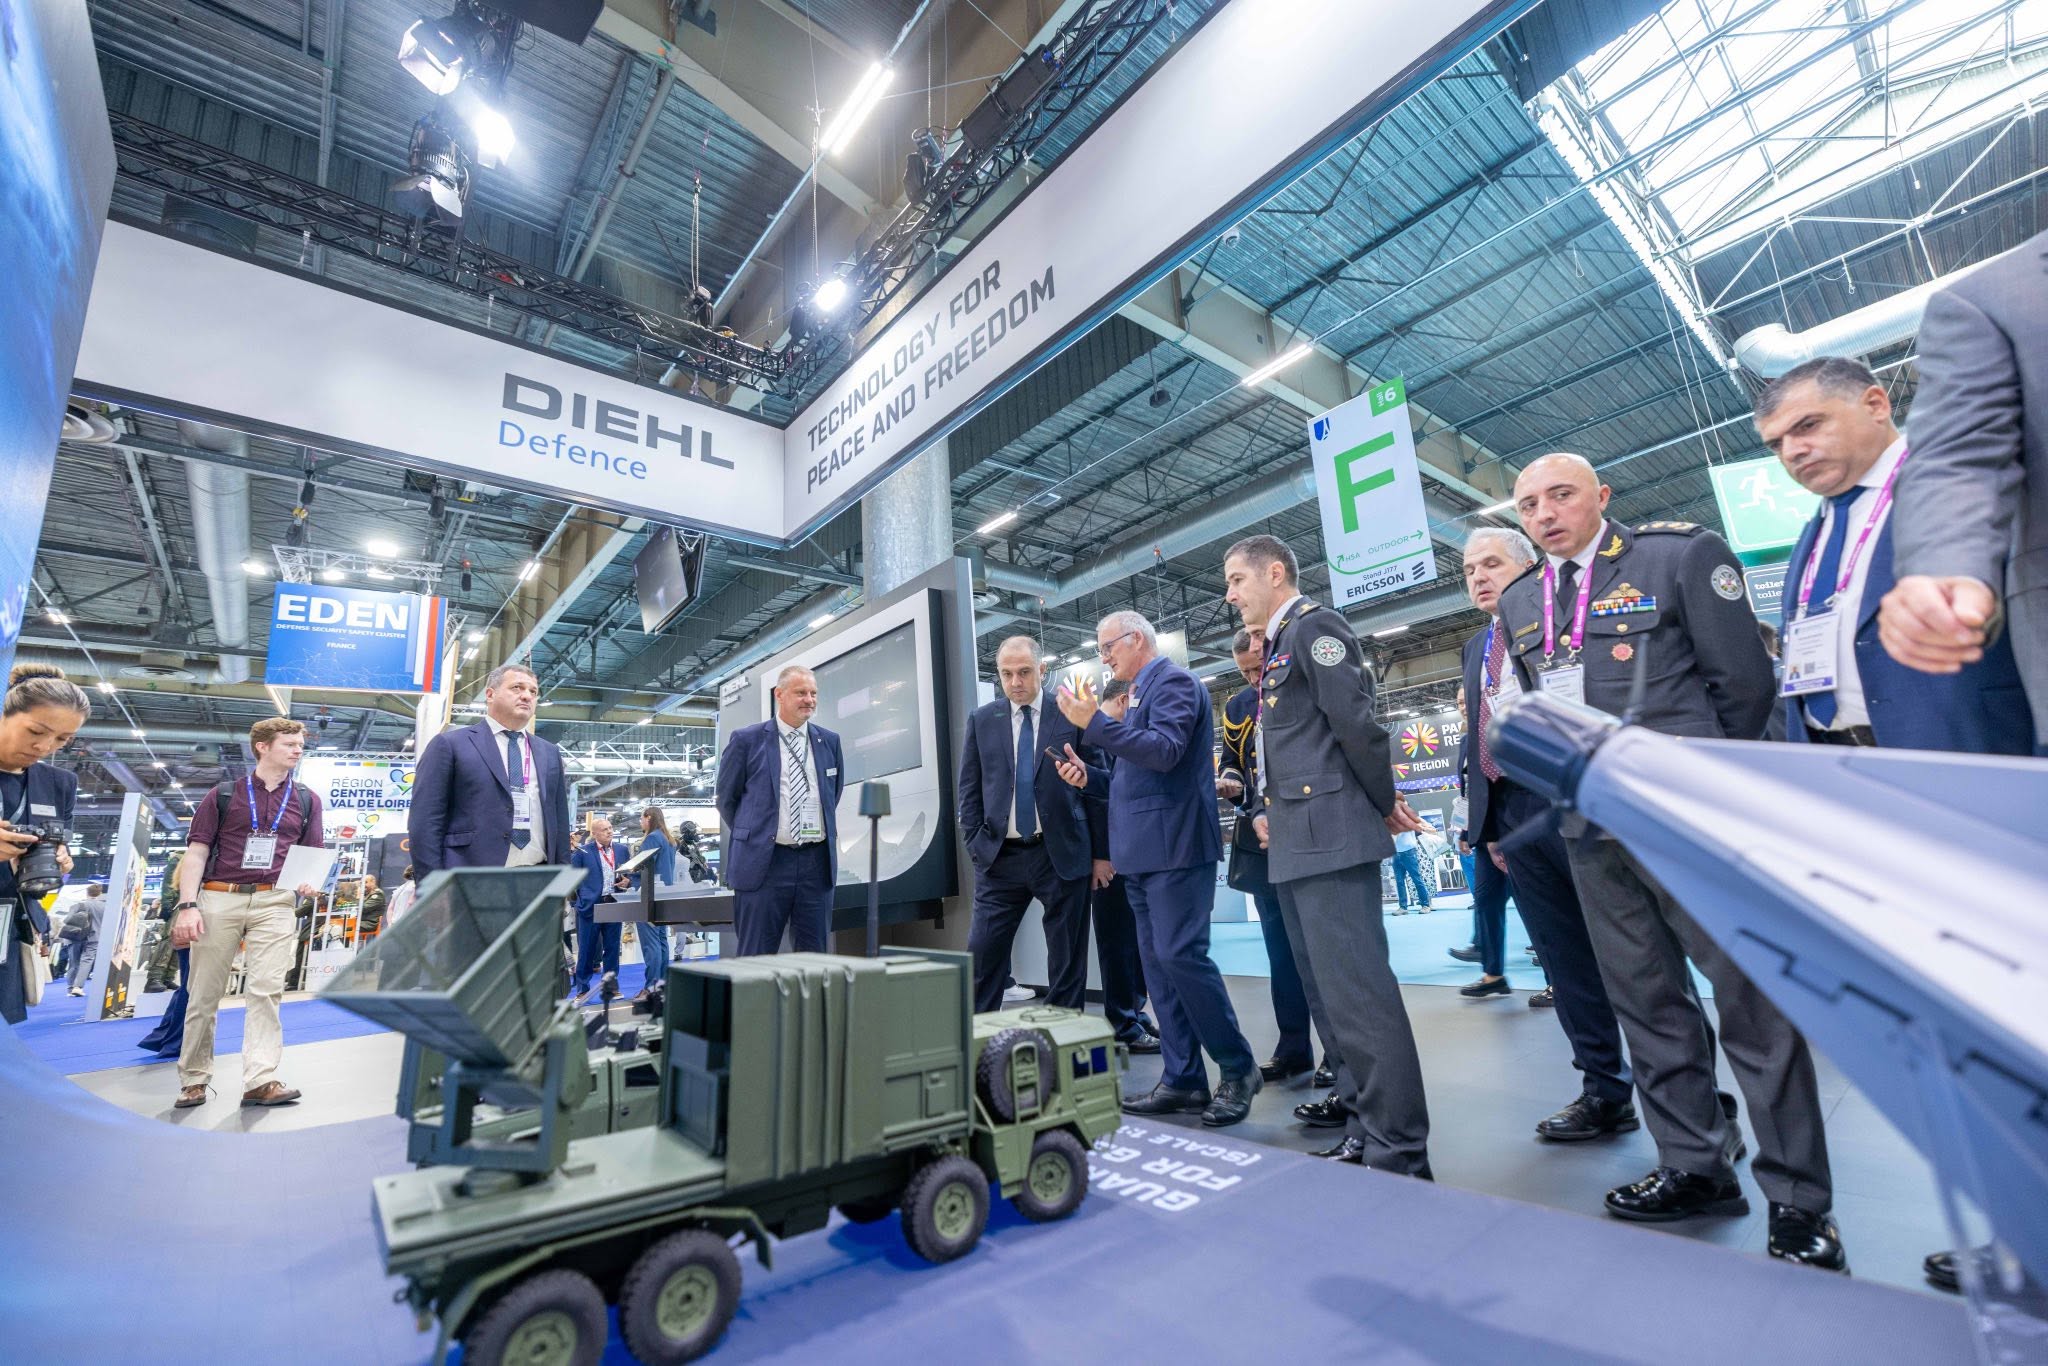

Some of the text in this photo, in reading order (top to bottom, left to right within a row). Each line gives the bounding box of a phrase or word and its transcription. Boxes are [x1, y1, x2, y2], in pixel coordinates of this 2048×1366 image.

[807, 259, 1001, 452] TECHNOLOGY FOR
[807, 265, 1055, 494] PEACE AND FREEDOM
[1384, 386, 1397, 402] 6
[502, 372, 735, 470] DIEHL
[499, 420, 647, 480] Defence
[1334, 431, 1396, 534] F
[1367, 535, 1409, 554] OUTDOOR
[1362, 565, 1398, 581] Stand J177
[1346, 572, 1405, 598] ERICSSON
[1754, 580, 1785, 590] toilet
[1757, 590, 1784, 599] toile
[277, 593, 409, 631] EDEN
[276, 623, 407, 639] DEFENSE SECURITY SAFETY CLUSTER
[326, 641, 357, 650] FRANCE
[1412, 758, 1450, 772] REGION
[332, 776, 383, 788] RÉGION
[330, 789, 383, 798] CENTRE
[330, 799, 411, 808] VAL DE LOIRE
[1141, 1157, 1243, 1192] FOR
